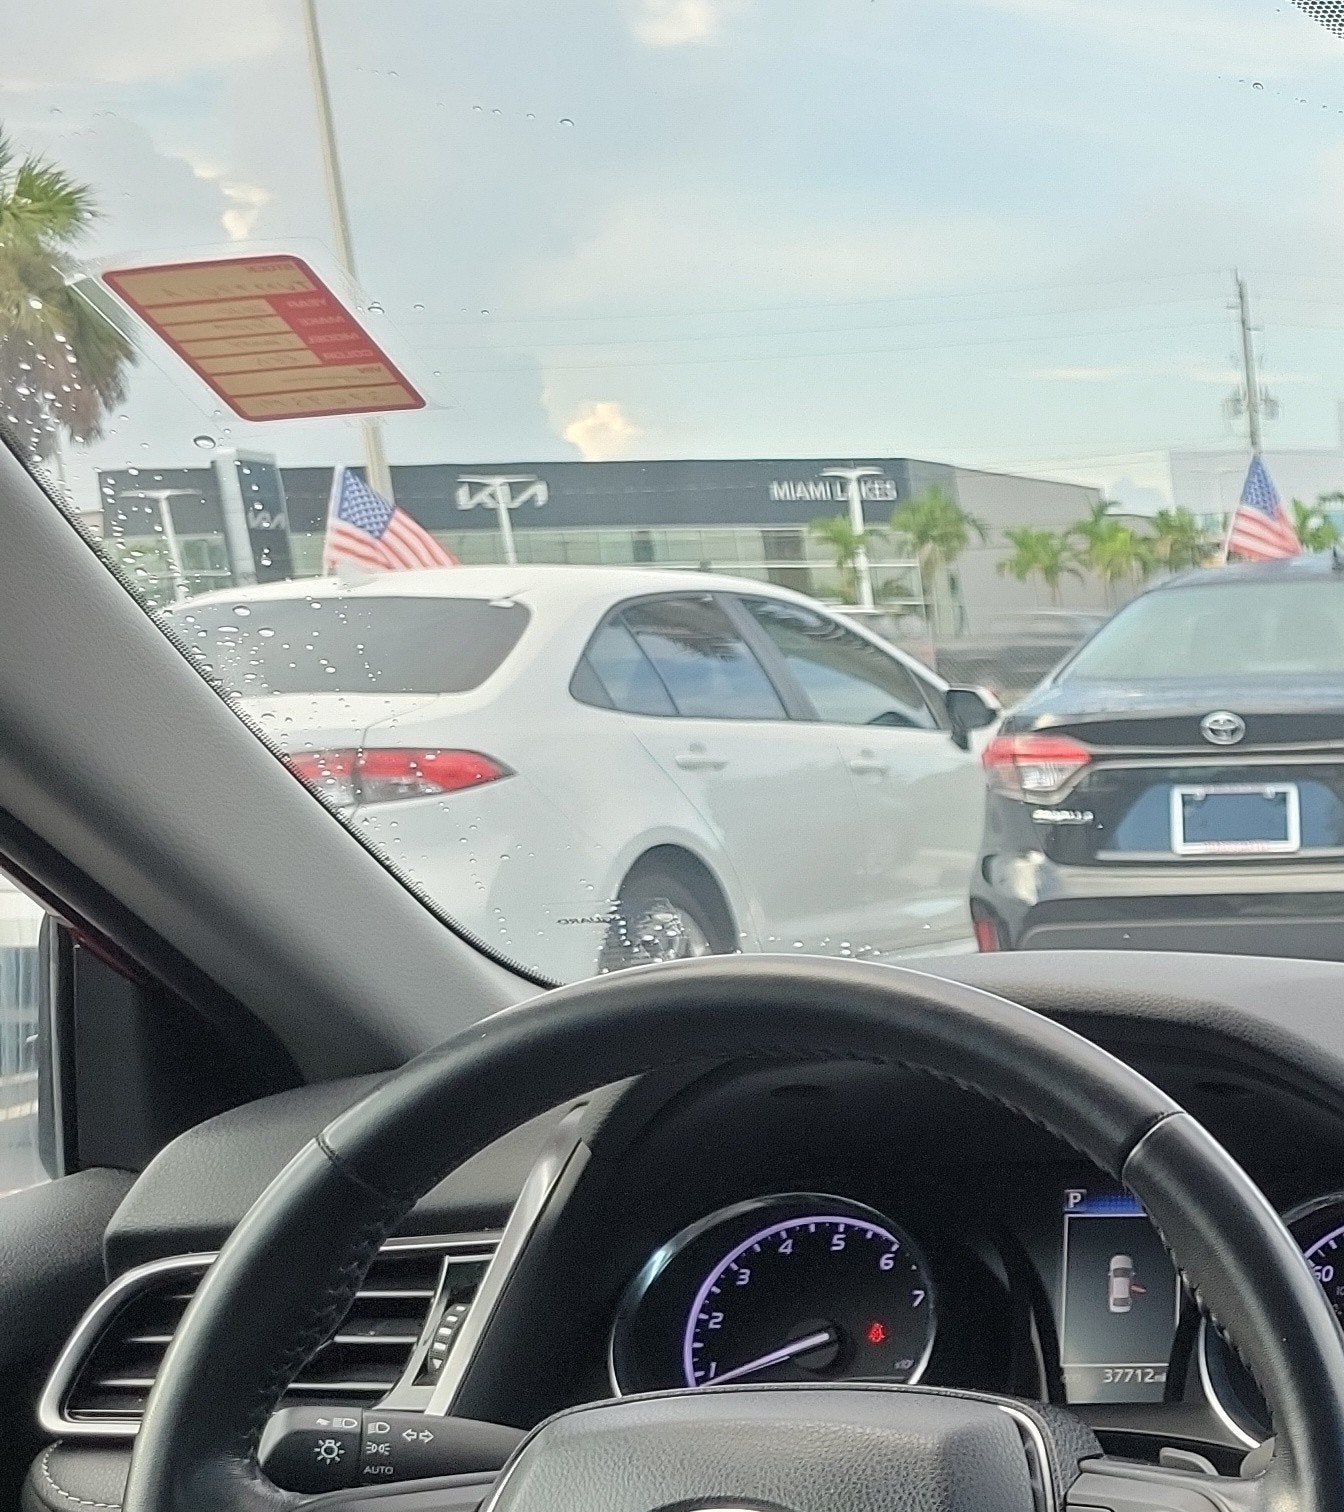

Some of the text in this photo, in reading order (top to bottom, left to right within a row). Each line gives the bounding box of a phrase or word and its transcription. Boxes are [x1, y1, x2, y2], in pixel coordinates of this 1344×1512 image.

[771, 479, 898, 501] MIAMI LKES
[1068, 1193, 1082, 1208] P
[778, 1239, 793, 1255] 4
[830, 1233, 846, 1251] 5
[880, 1253, 895, 1270] 6
[736, 1269, 750, 1285] 3
[912, 1290, 925, 1307] 7
[708, 1312, 724, 1329] 2
[710, 1361, 717, 1378] 1
[1103, 1369, 1154, 1383] 37712
[363, 1464, 394, 1476] AUTO
